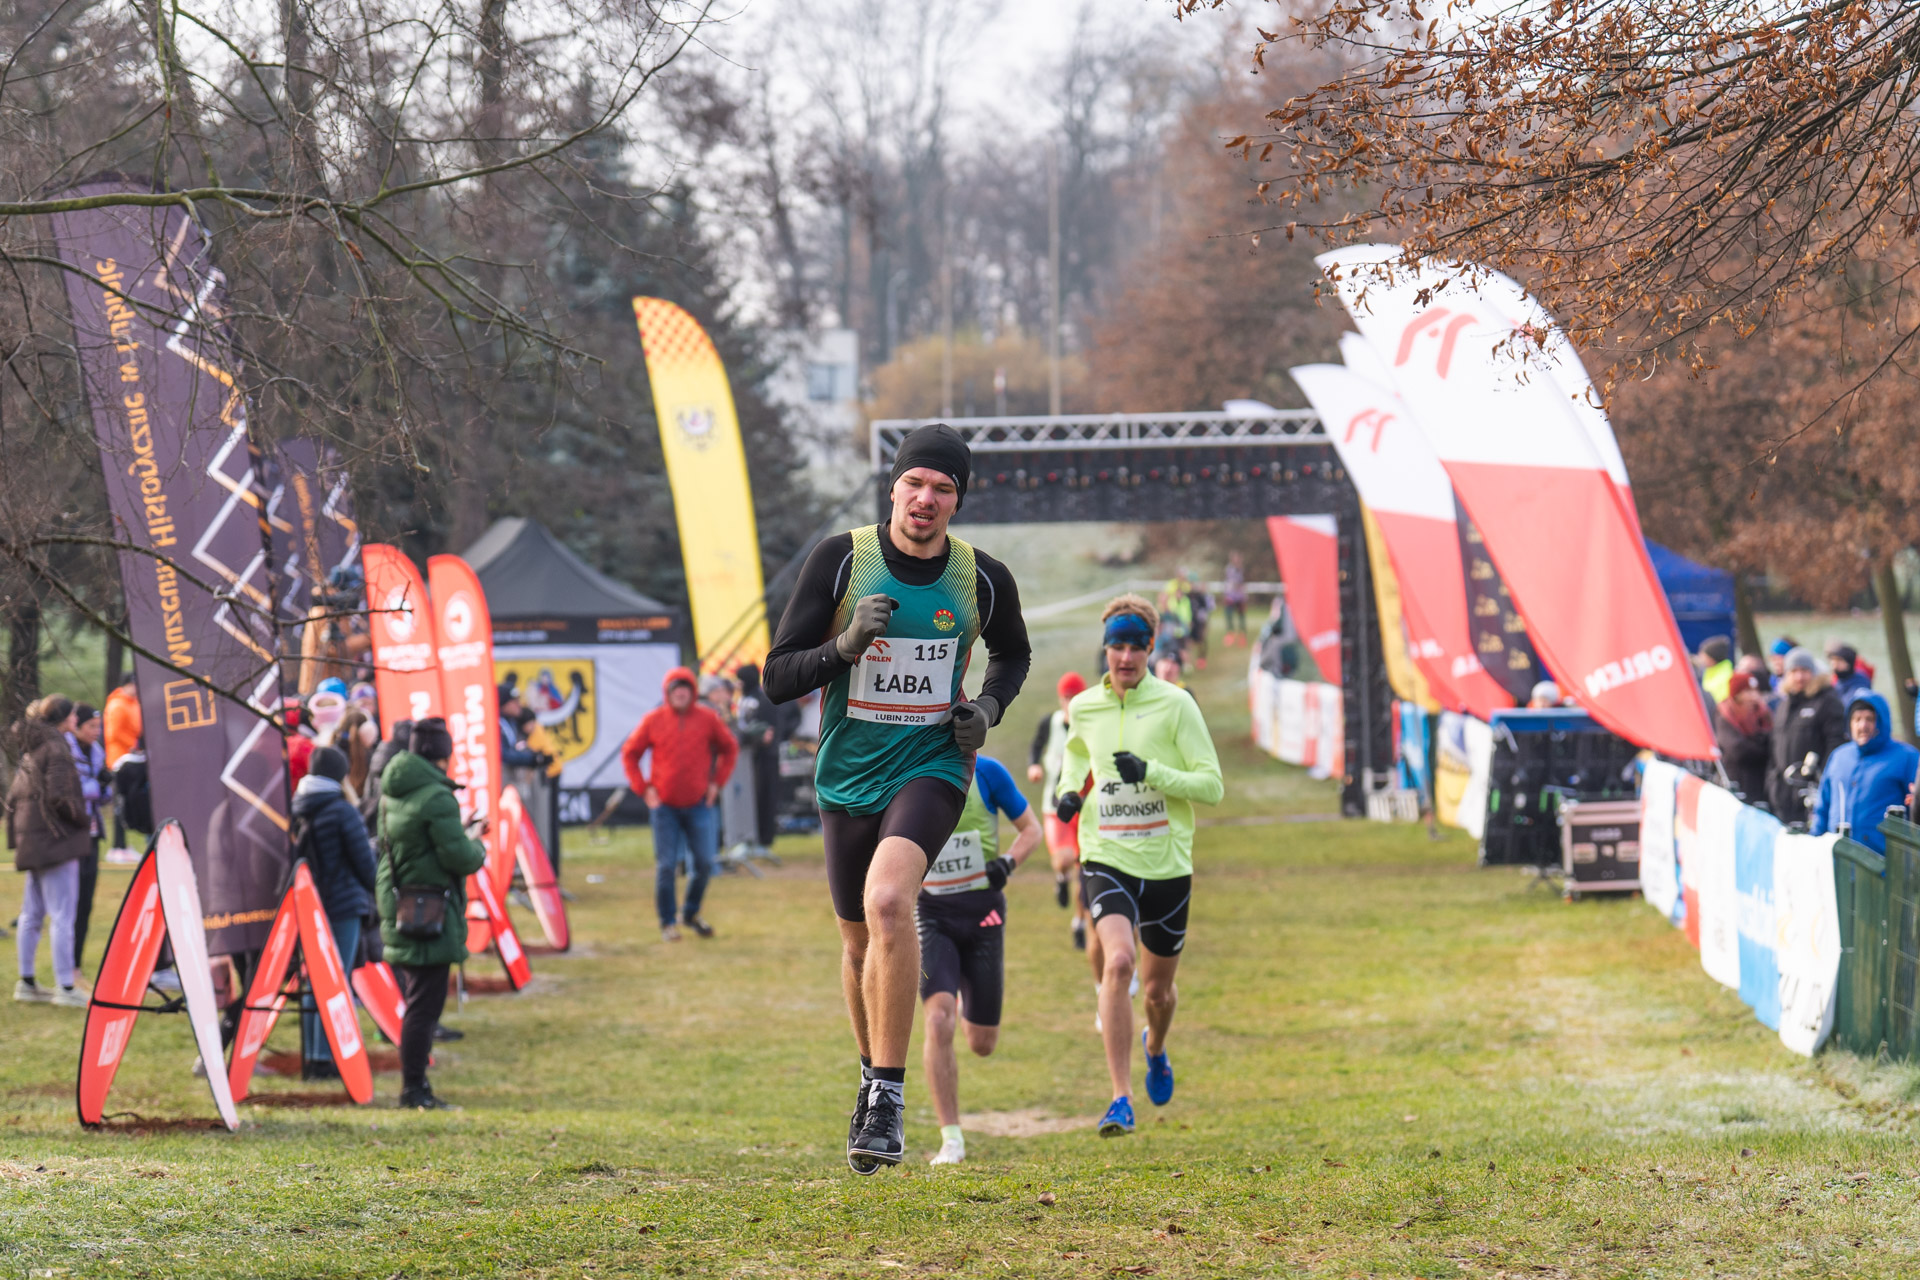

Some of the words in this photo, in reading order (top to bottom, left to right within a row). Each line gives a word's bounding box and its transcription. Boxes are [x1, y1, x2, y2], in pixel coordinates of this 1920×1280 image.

[865, 654, 892, 662] ORLEN
[914, 643, 948, 661] 115
[873, 673, 933, 694] ŁABA
[875, 713, 902, 721] LUBIN
[1101, 781, 1121, 795] 4F
[1100, 800, 1164, 817] LUBOIŃSKI
[953, 836, 970, 849] 76
